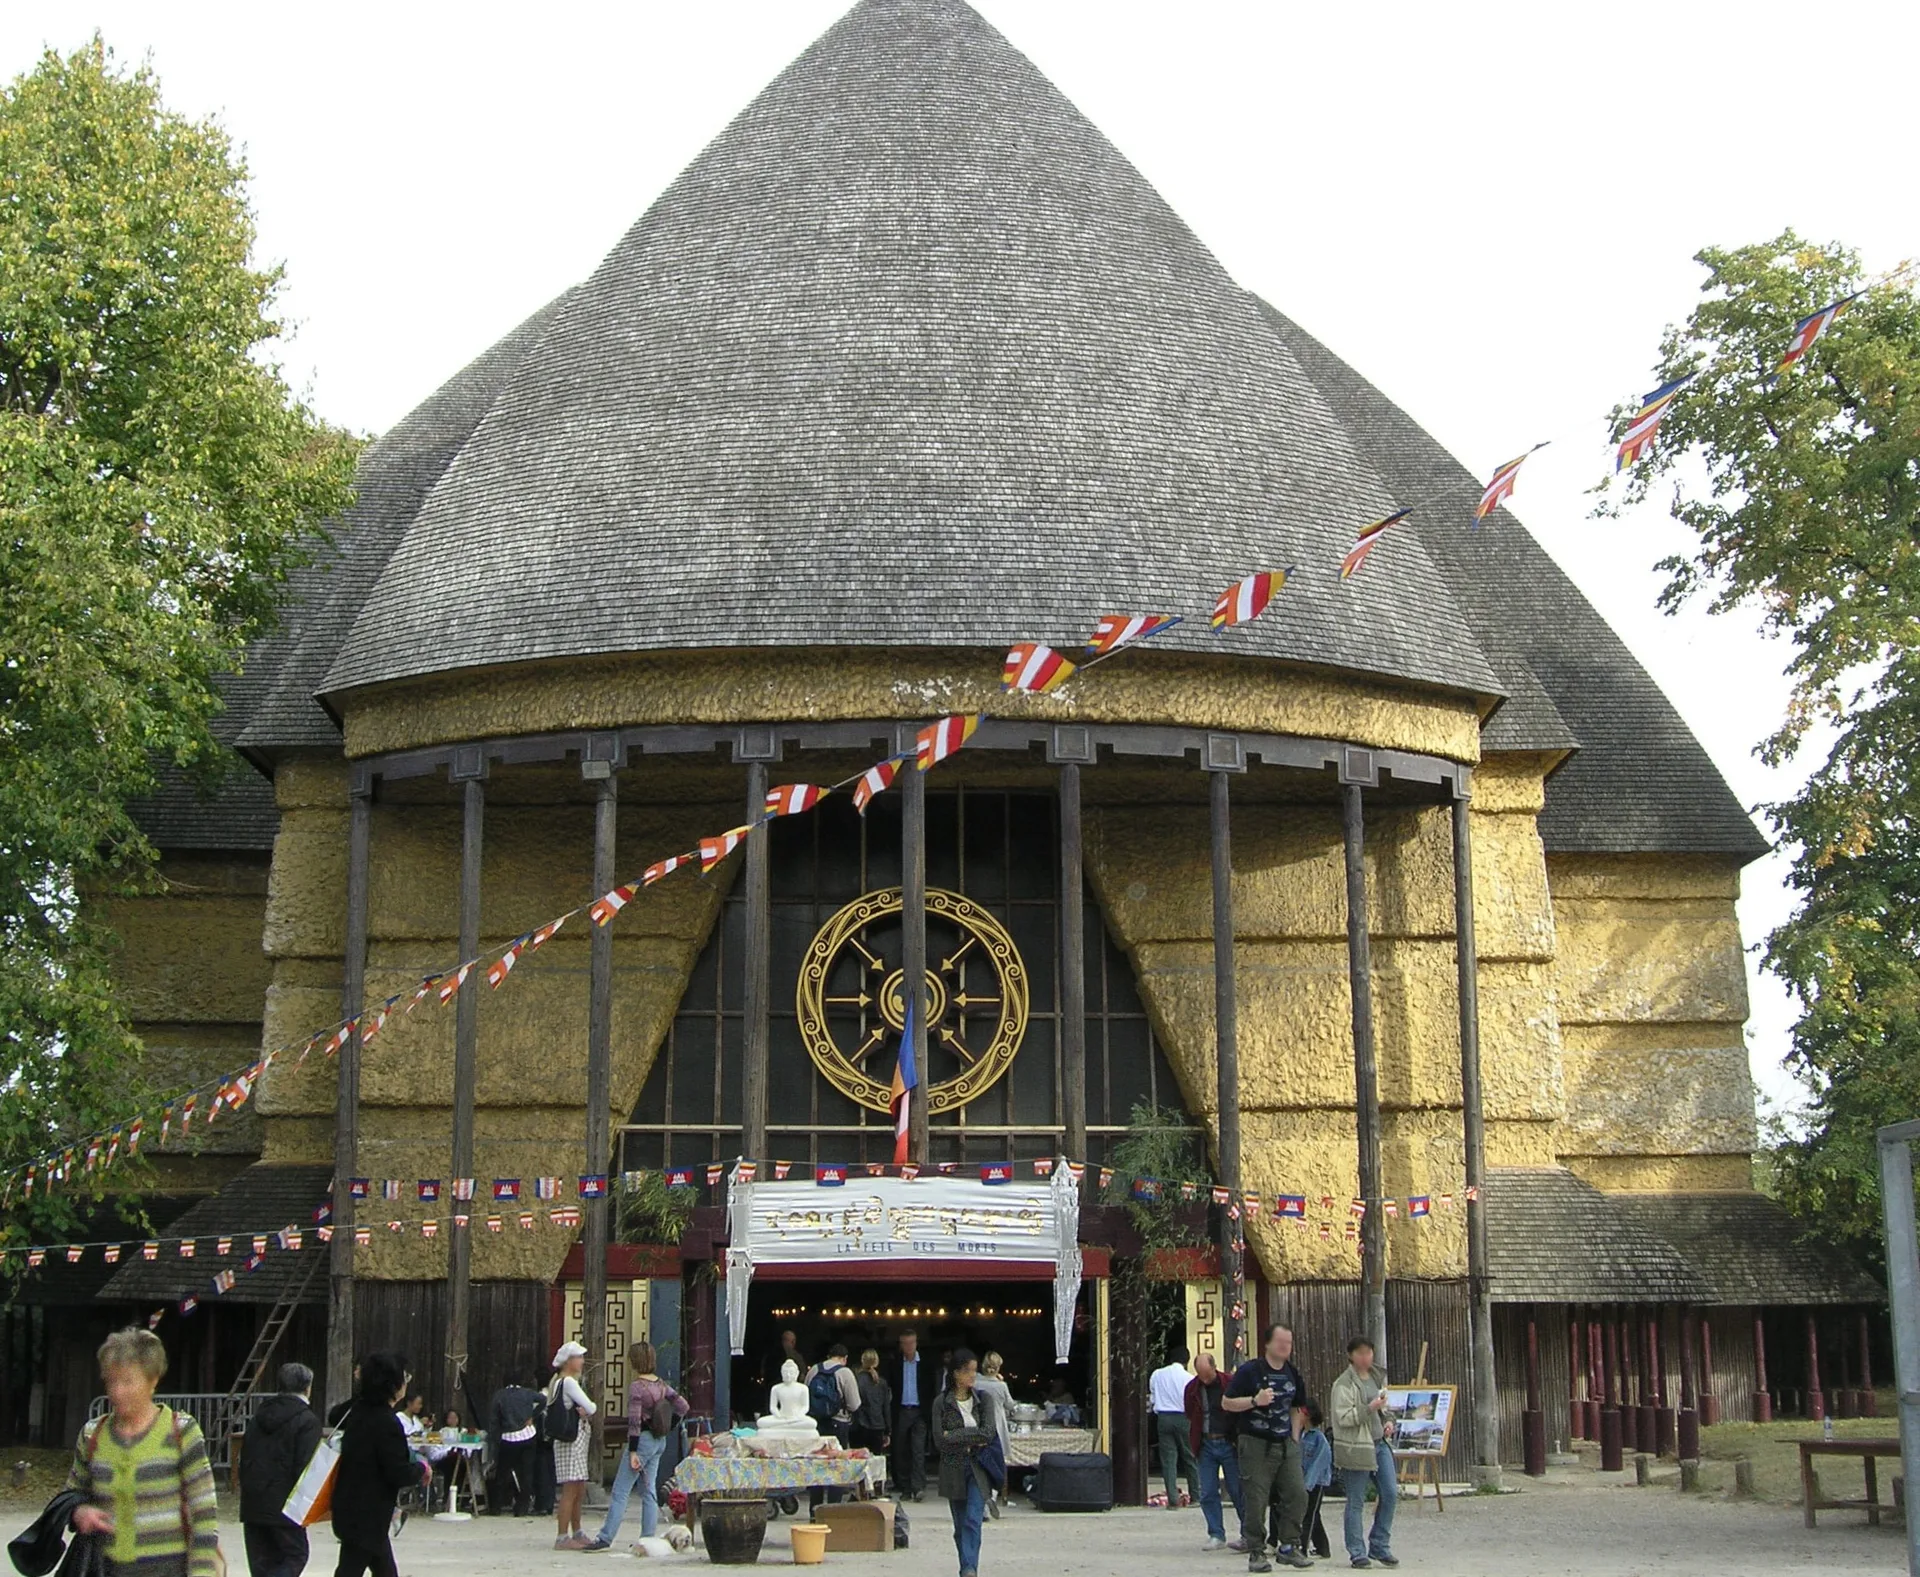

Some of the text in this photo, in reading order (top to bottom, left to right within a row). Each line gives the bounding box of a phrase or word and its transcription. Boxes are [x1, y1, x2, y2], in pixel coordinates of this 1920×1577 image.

[837, 1243, 851, 1254] LA
[913, 1241, 936, 1252] DES
[958, 1242, 997, 1253] MORTS
